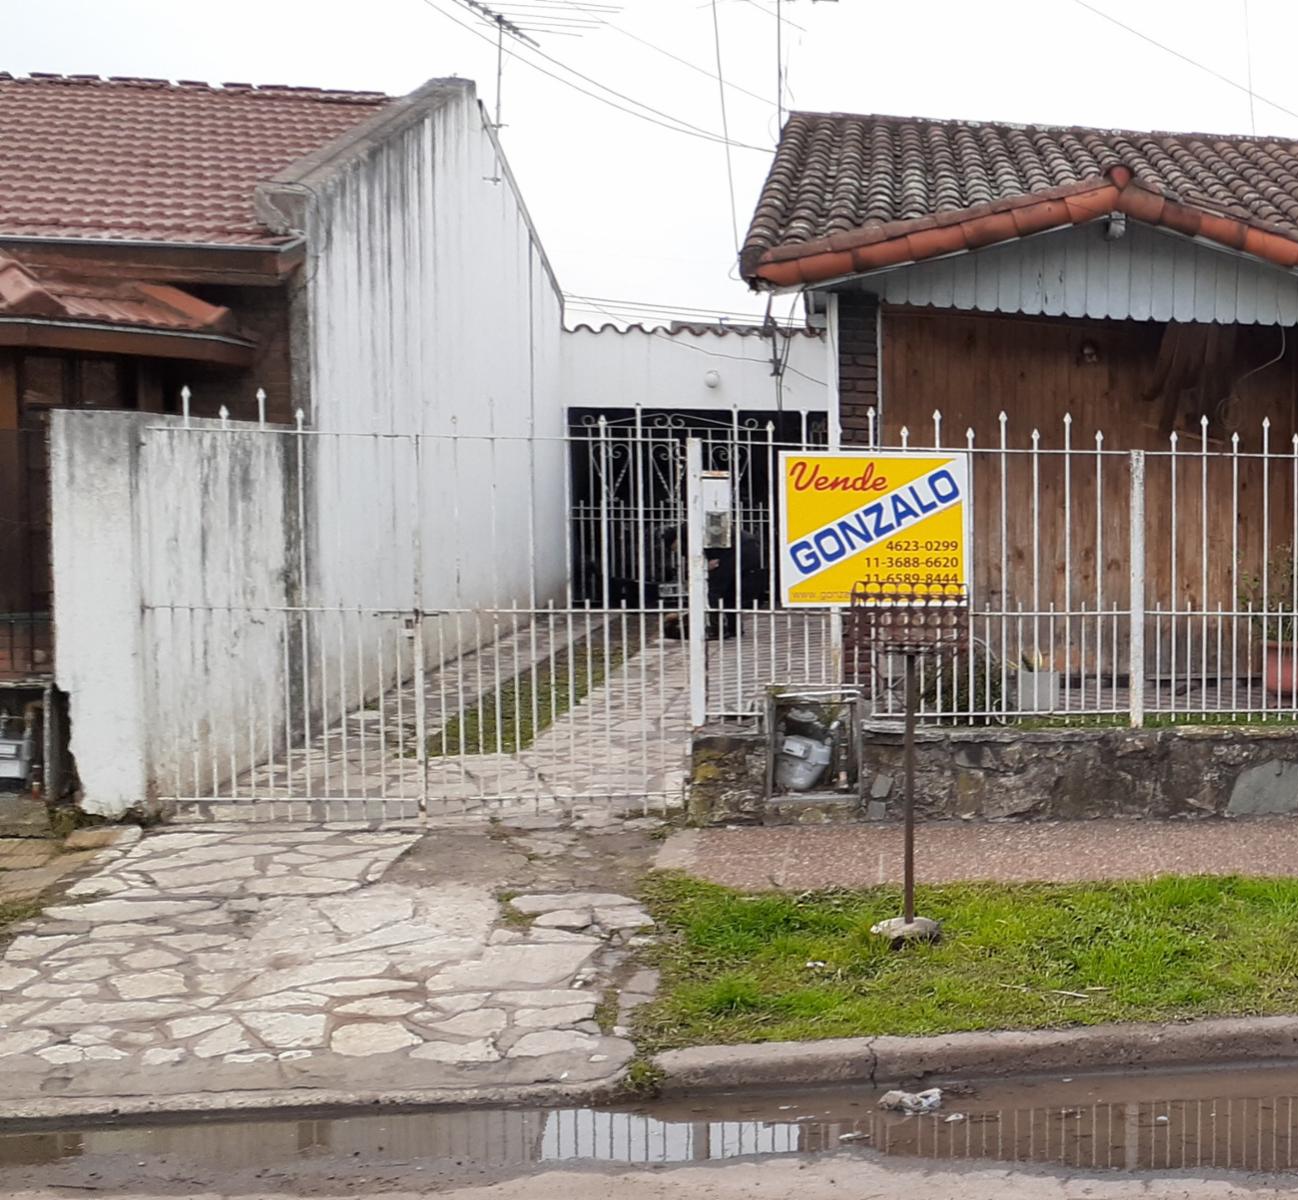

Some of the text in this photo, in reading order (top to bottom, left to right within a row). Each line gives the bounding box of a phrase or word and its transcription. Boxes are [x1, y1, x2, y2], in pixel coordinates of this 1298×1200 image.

[789, 461, 889, 492] Vende
[789, 469, 960, 575] GONZALO
[886, 540, 958, 552] 4623-0299
[865, 557, 959, 568] 11-3688-6620
[865, 573, 958, 583] 11-6589-8444
